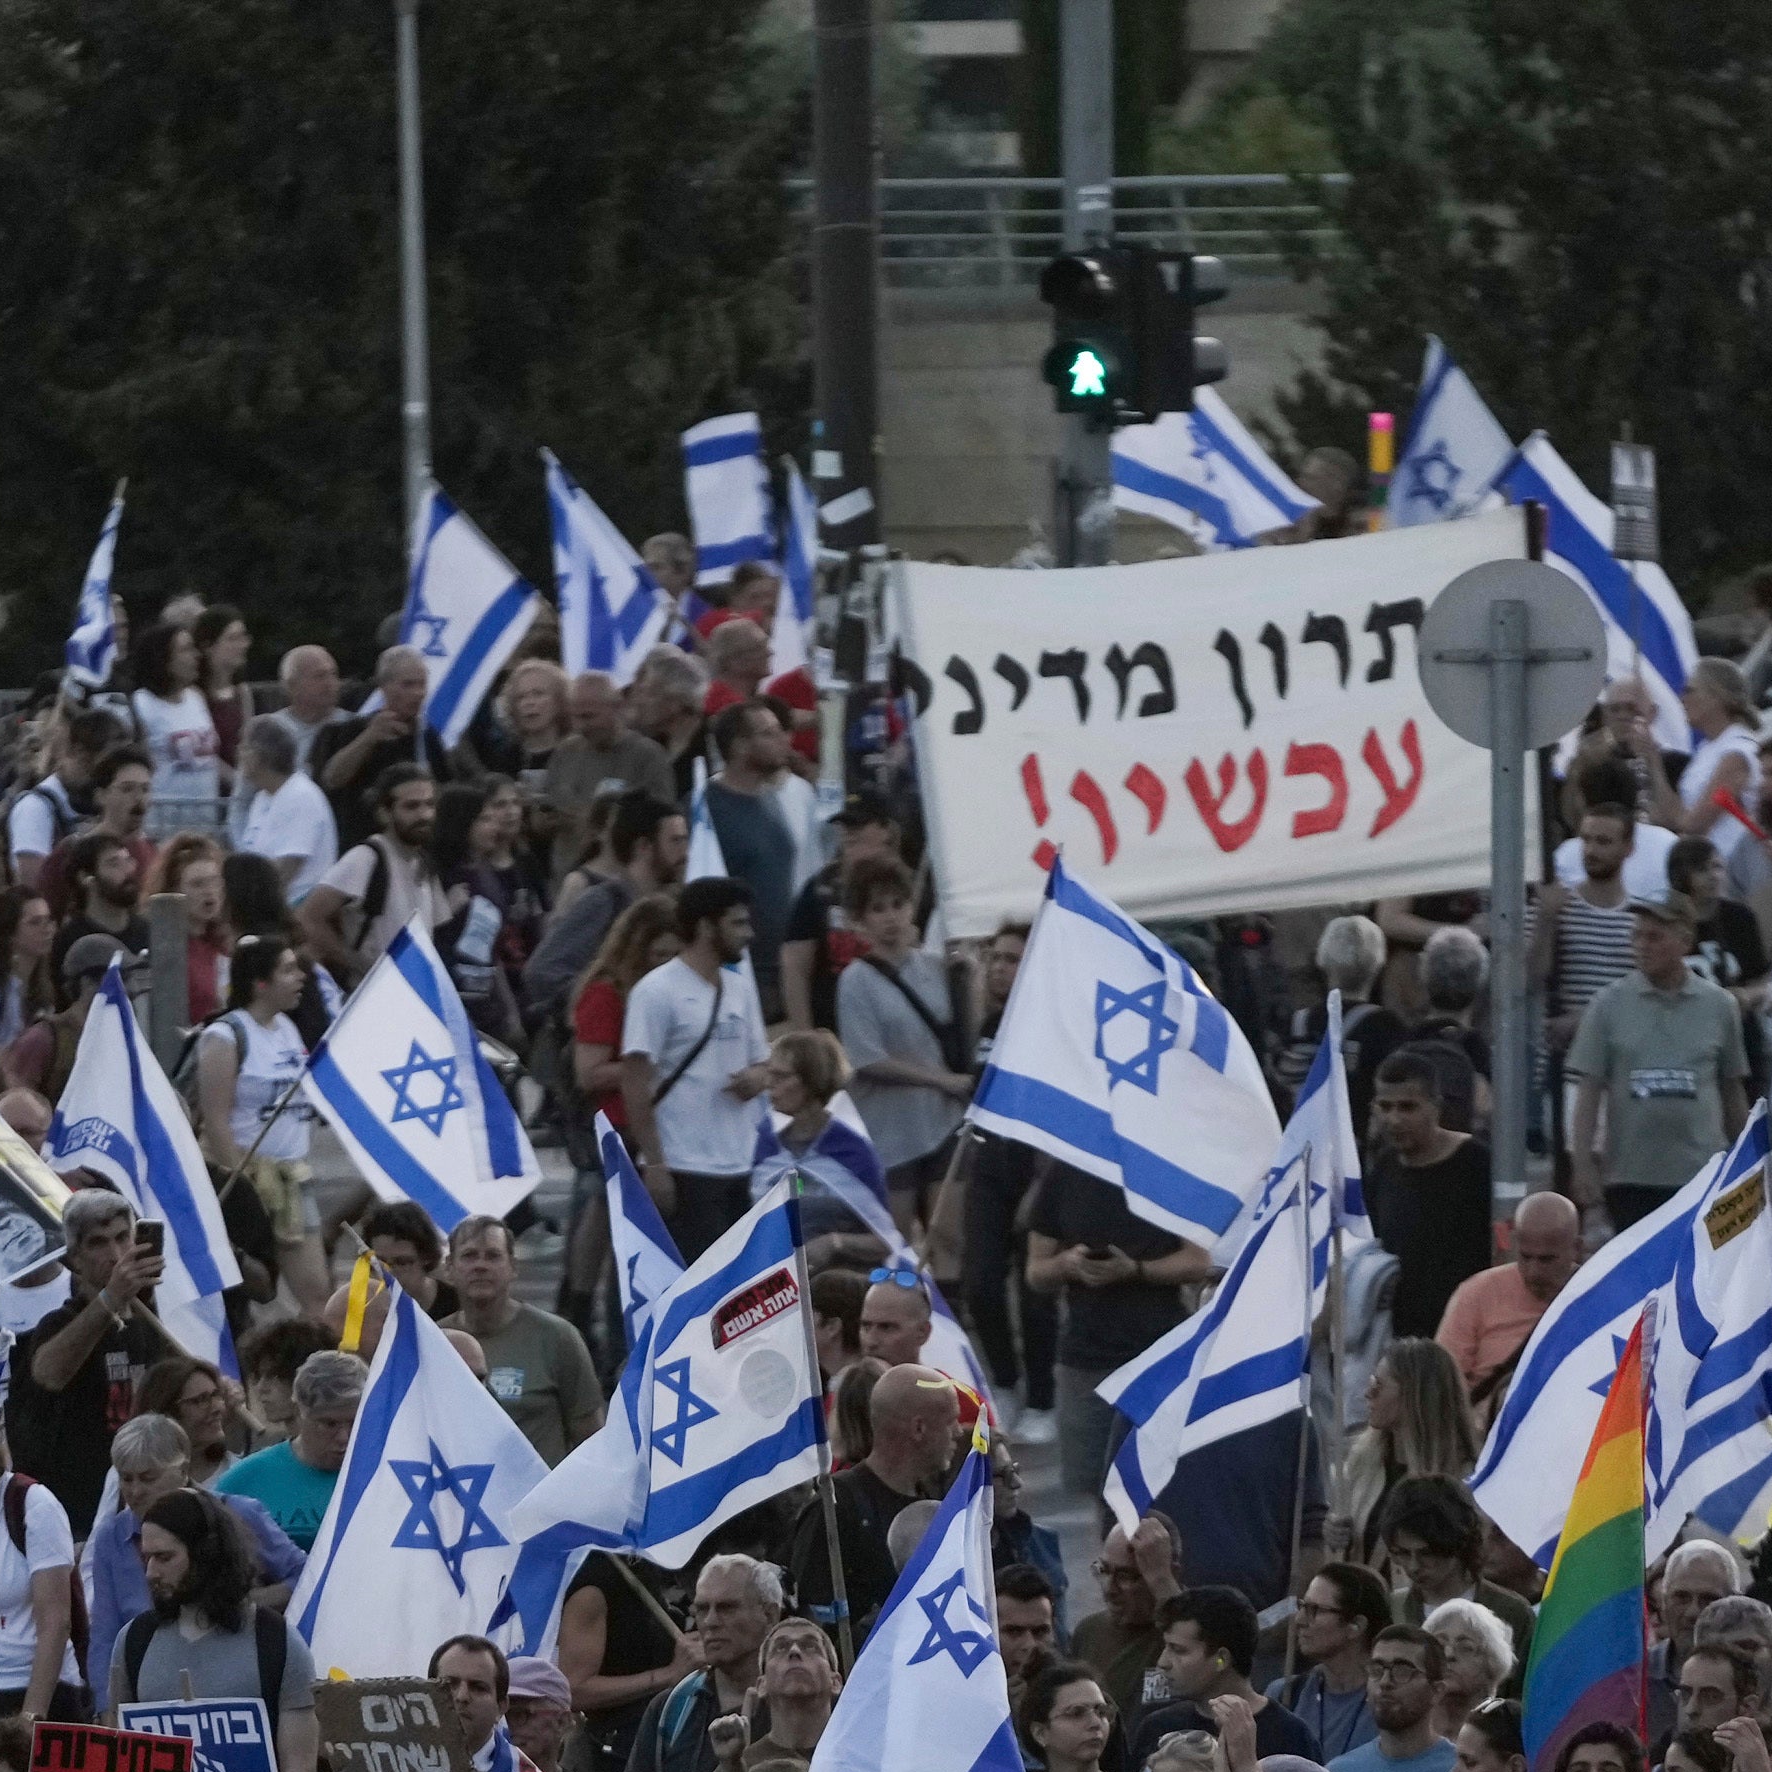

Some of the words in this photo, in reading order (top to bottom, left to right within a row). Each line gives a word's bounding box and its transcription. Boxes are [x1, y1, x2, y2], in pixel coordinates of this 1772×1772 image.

[1213, 597, 1424, 728] תרון
[1021, 719, 1424, 872] עכשיו!
[764, 1285, 799, 1313] אתה
[722, 1304, 767, 1339] אשם
[360, 1691, 440, 1733] היום
